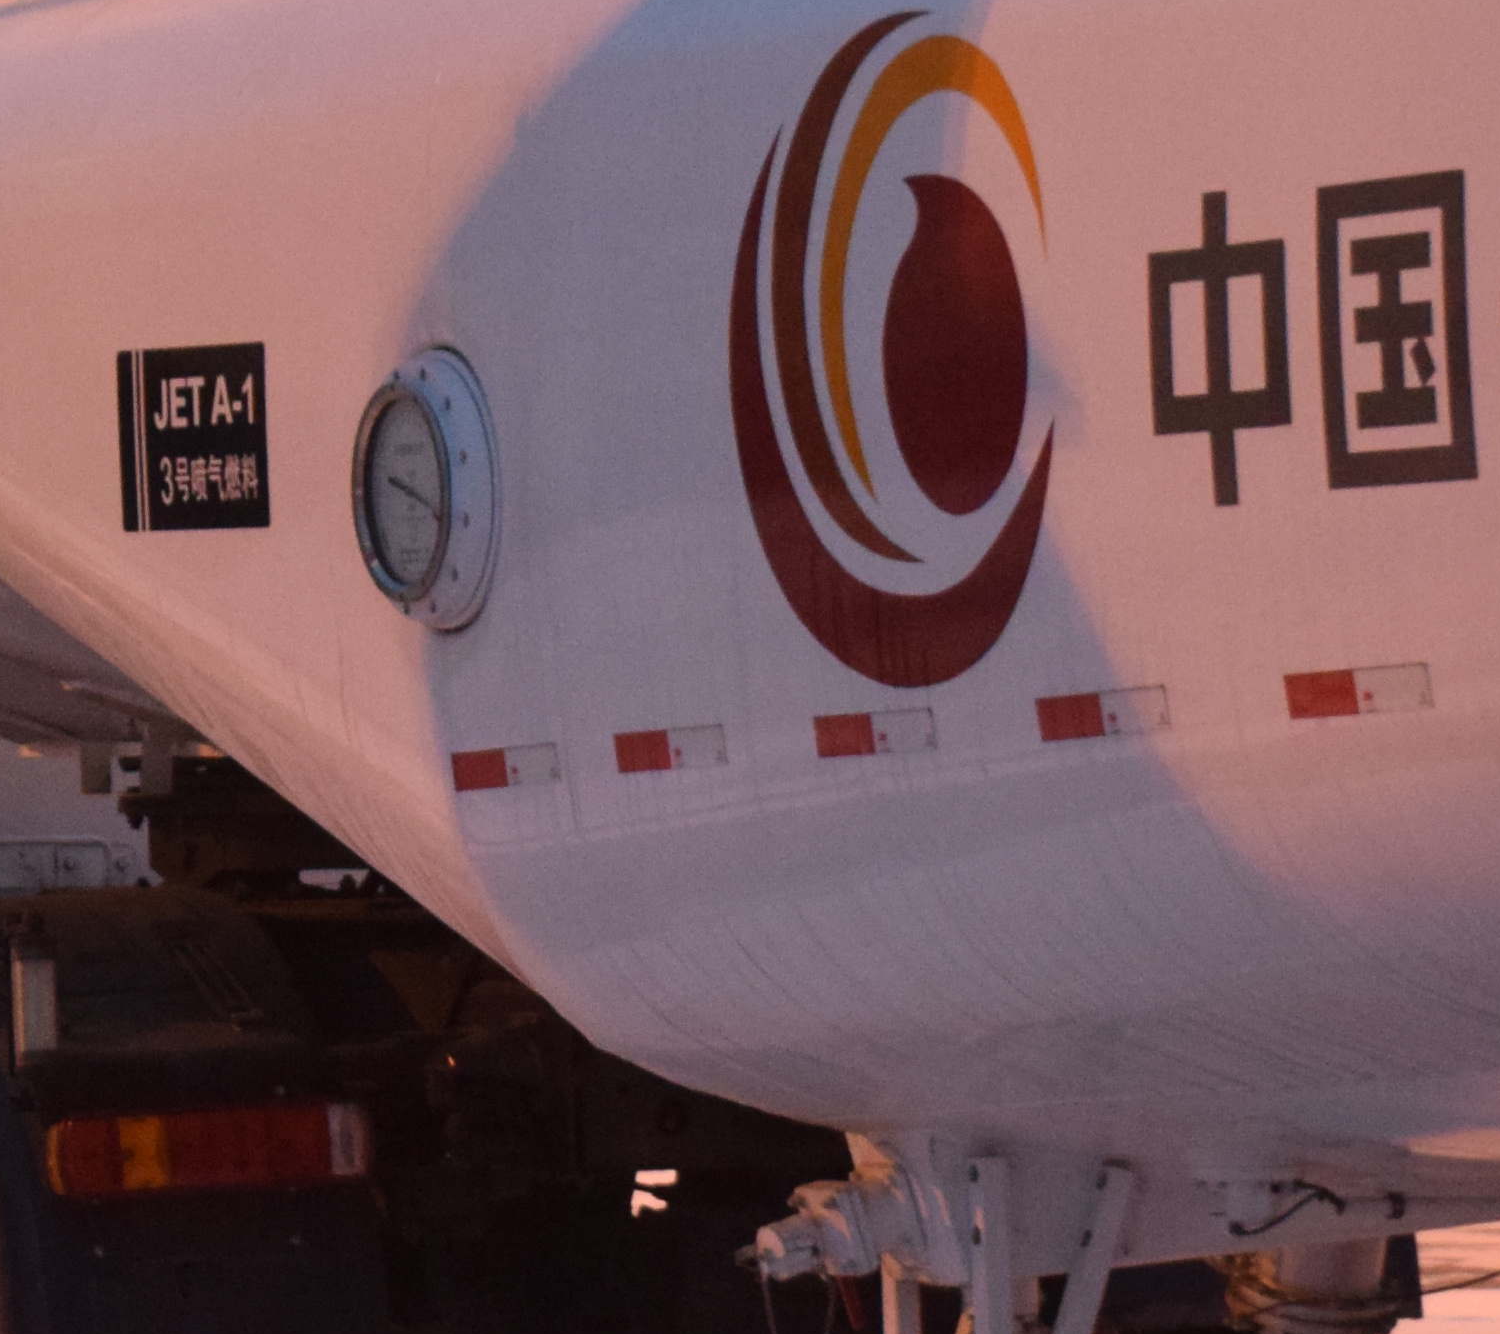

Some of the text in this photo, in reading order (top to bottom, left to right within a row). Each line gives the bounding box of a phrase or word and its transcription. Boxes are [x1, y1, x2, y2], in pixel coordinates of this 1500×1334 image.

[153, 373, 255, 430] JET A-1
[159, 454, 259, 506] 3号喷气燃料
